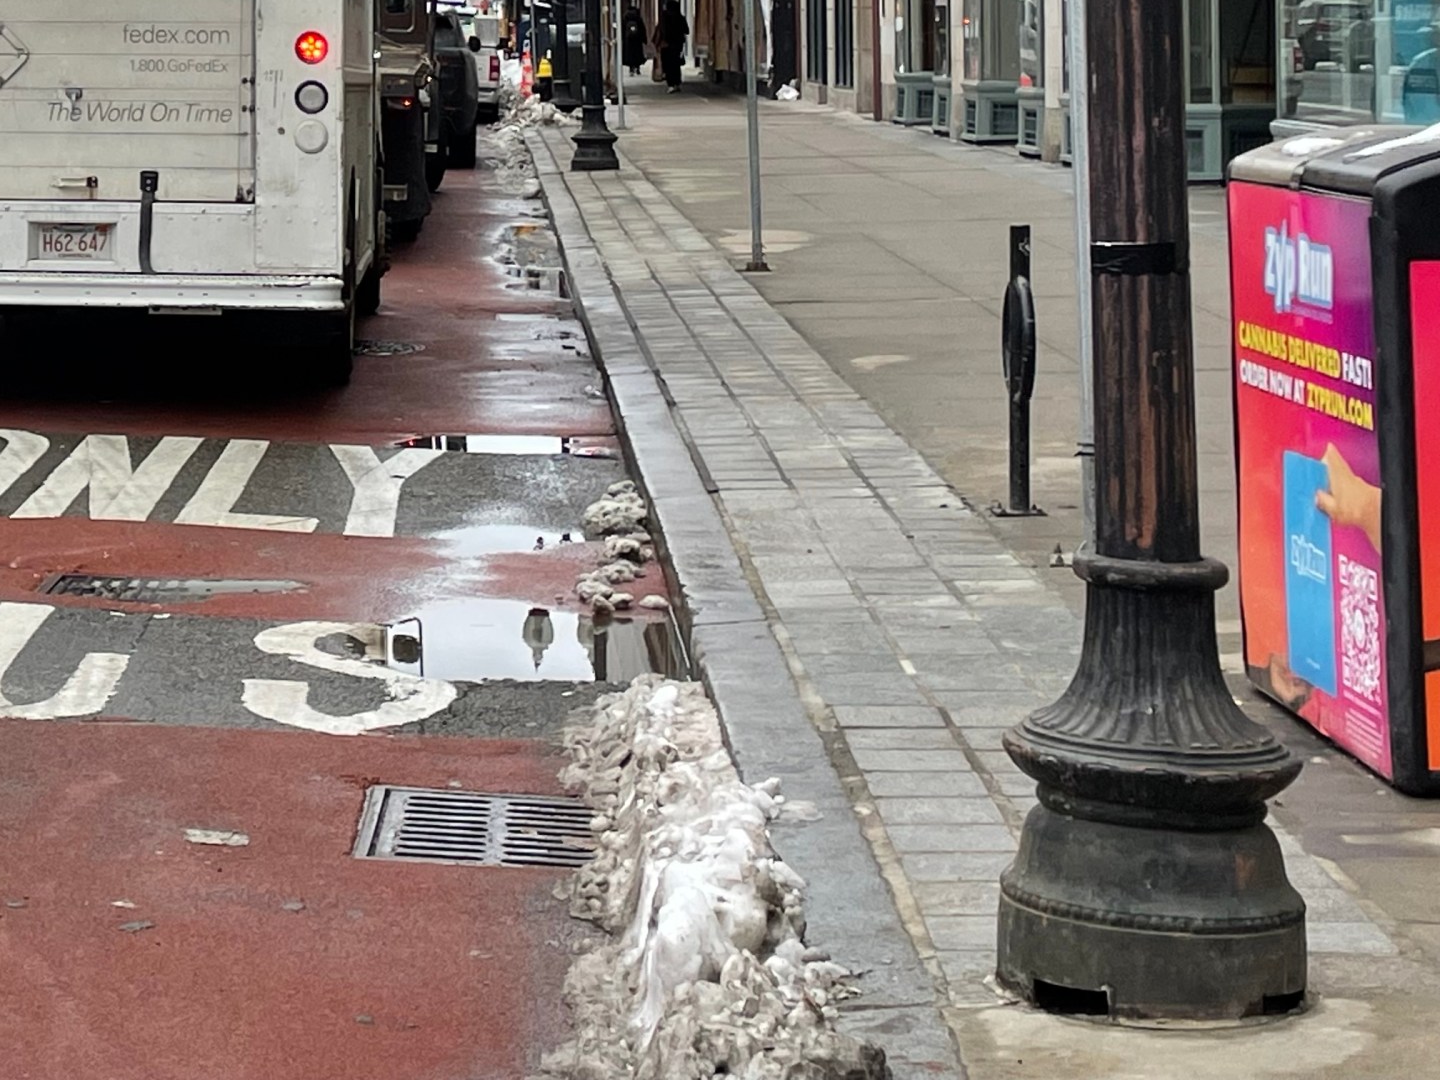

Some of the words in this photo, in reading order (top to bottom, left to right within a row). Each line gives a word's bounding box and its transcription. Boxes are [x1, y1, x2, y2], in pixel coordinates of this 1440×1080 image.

[123, 24, 230, 44] fedex.com
[47, 102, 82, 123] The
[87, 102, 145, 123] World
[150, 103, 179, 123] On
[185, 103, 233, 124] Time
[1297, 233, 1333, 309] Run
[1239, 320, 1287, 360] CANNABIS
[1288, 335, 1340, 378] DELIVERED
[1341, 352, 1372, 390] FAST!
[1240, 358, 1268, 391] ORDER
[1269, 368, 1293, 400] NOW
[1293, 378, 1305, 405] AT
[1306, 382, 1374, 431] ZYPRUN.COM
